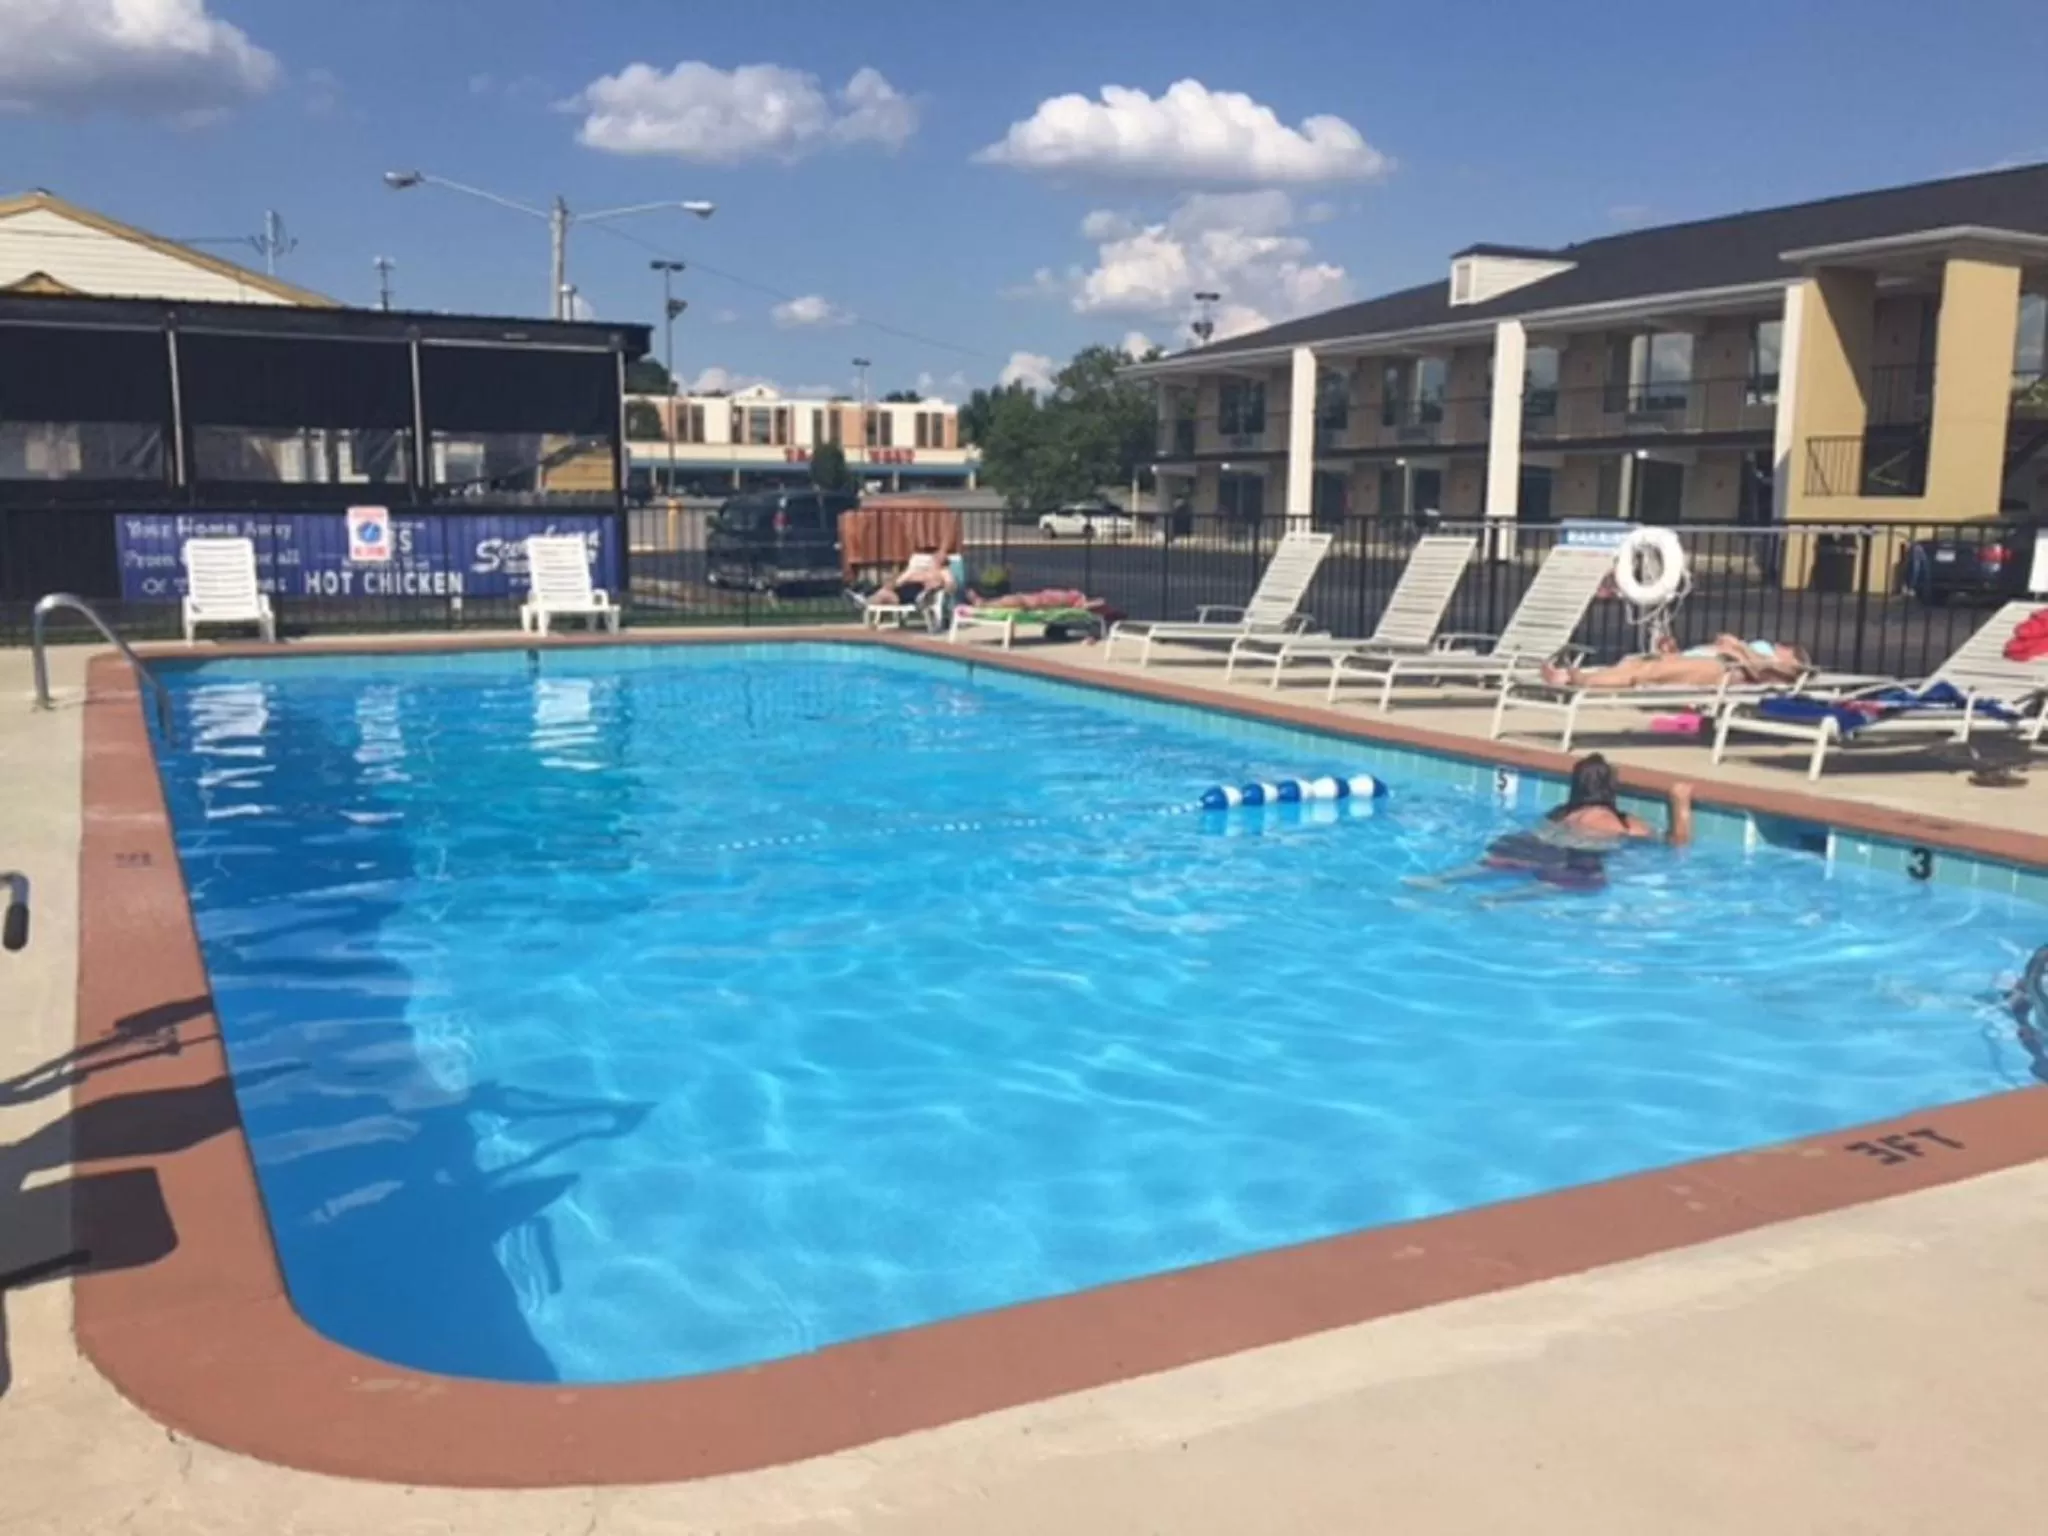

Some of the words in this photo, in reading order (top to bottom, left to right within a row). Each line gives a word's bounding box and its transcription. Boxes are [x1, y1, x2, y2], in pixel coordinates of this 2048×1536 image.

[304, 570, 354, 596] HOT
[363, 571, 464, 597] CHICKEN
[1907, 846, 1932, 881] 3
